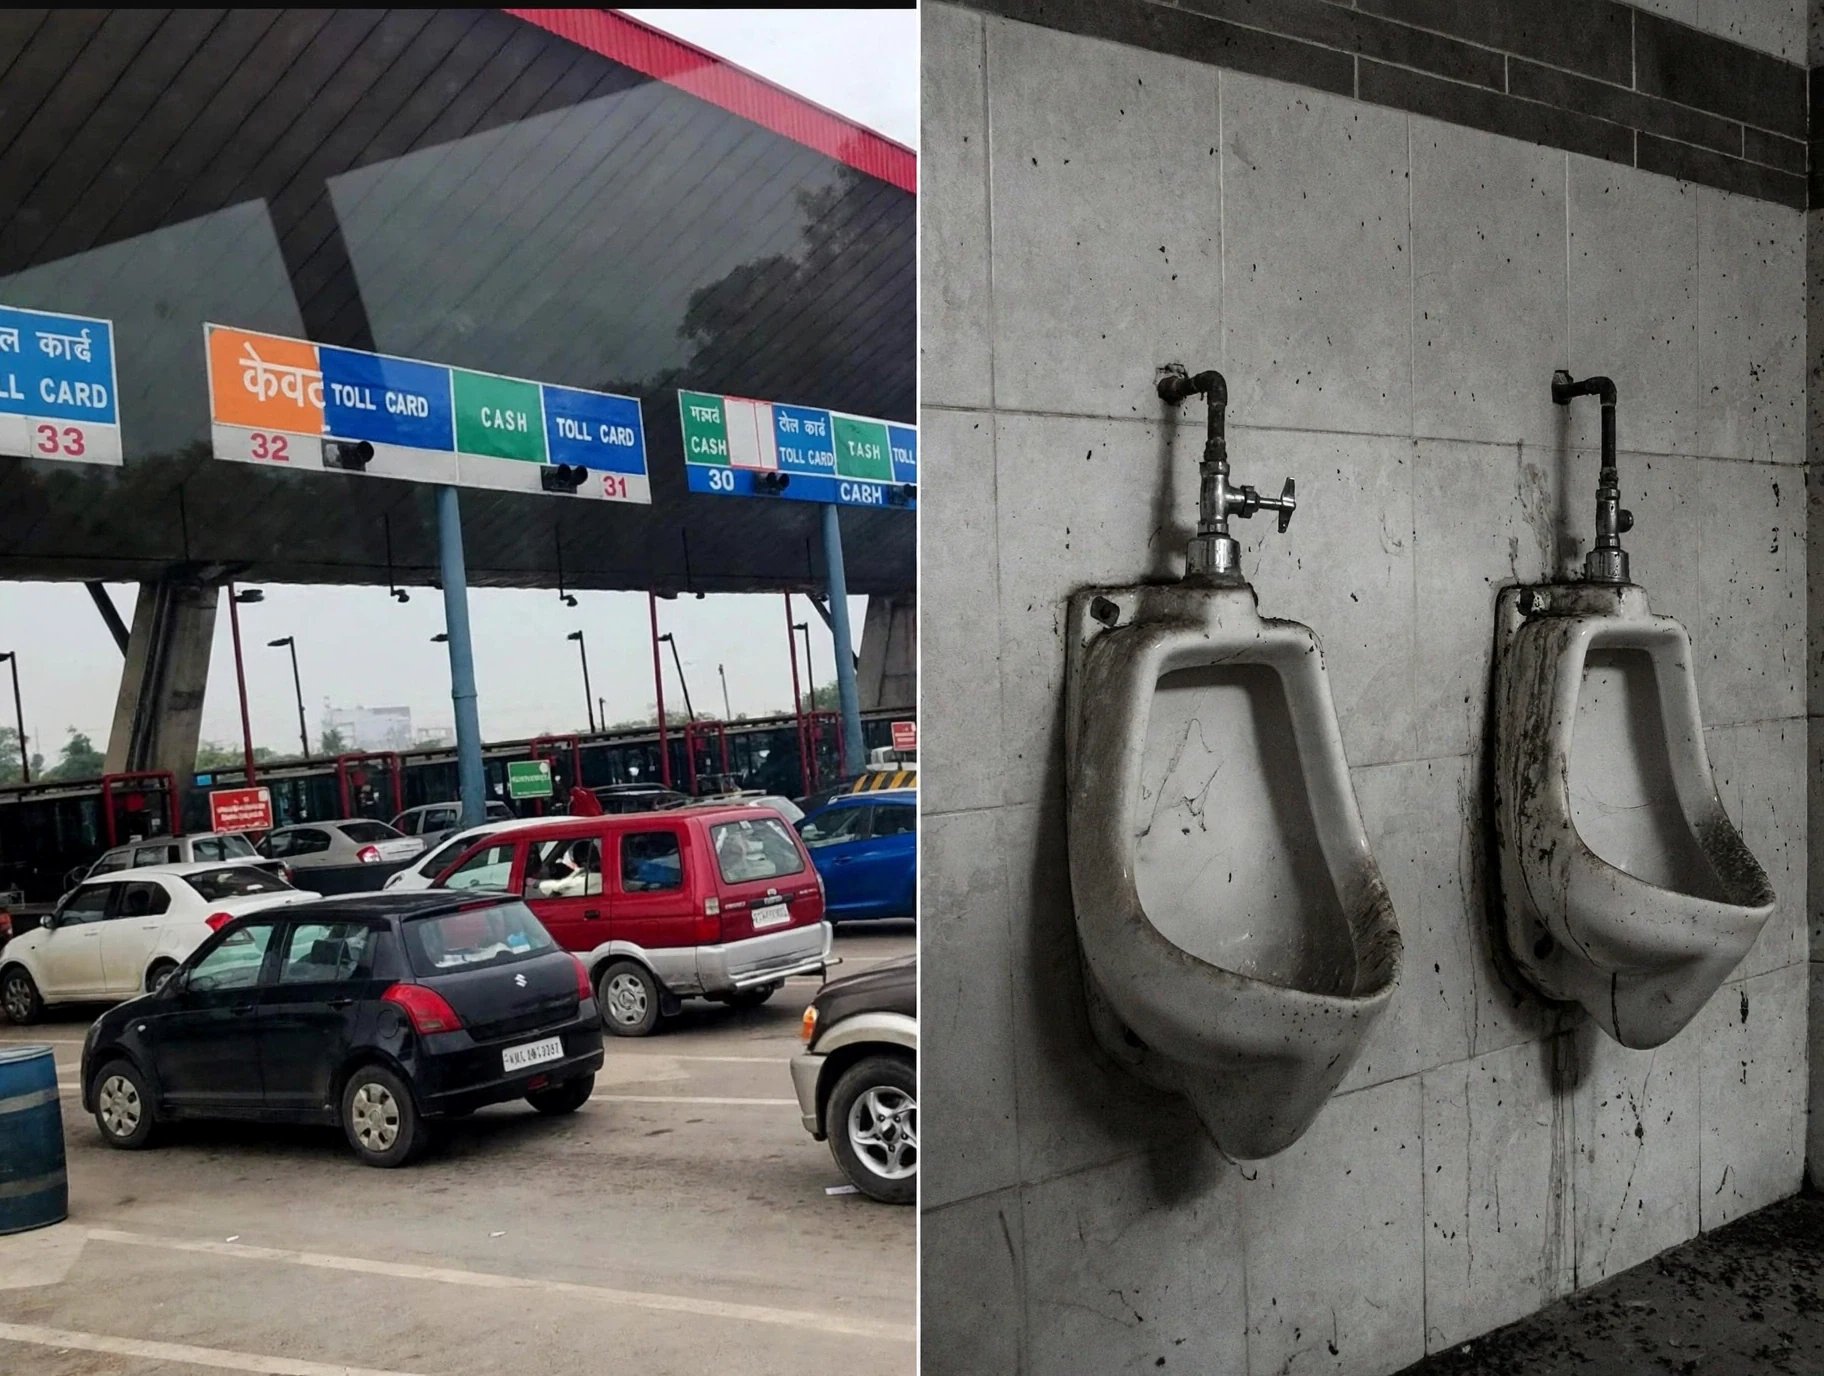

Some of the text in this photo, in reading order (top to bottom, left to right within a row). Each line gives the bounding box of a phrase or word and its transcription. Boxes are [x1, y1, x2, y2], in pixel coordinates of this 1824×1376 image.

[40, 377, 108, 409] CARD
[331, 383, 429, 418] TOLL CARD
[481, 406, 528, 432] CASH
[556, 417, 635, 447] TOLL CARD
[37, 424, 86, 457] 33
[250, 432, 290, 461] 32
[691, 436, 727, 456] CASH
[779, 446, 835, 467] TOLL CARD
[892, 447, 916, 465] TOLL
[603, 475, 627, 498] 31
[708, 469, 735, 491] 30
